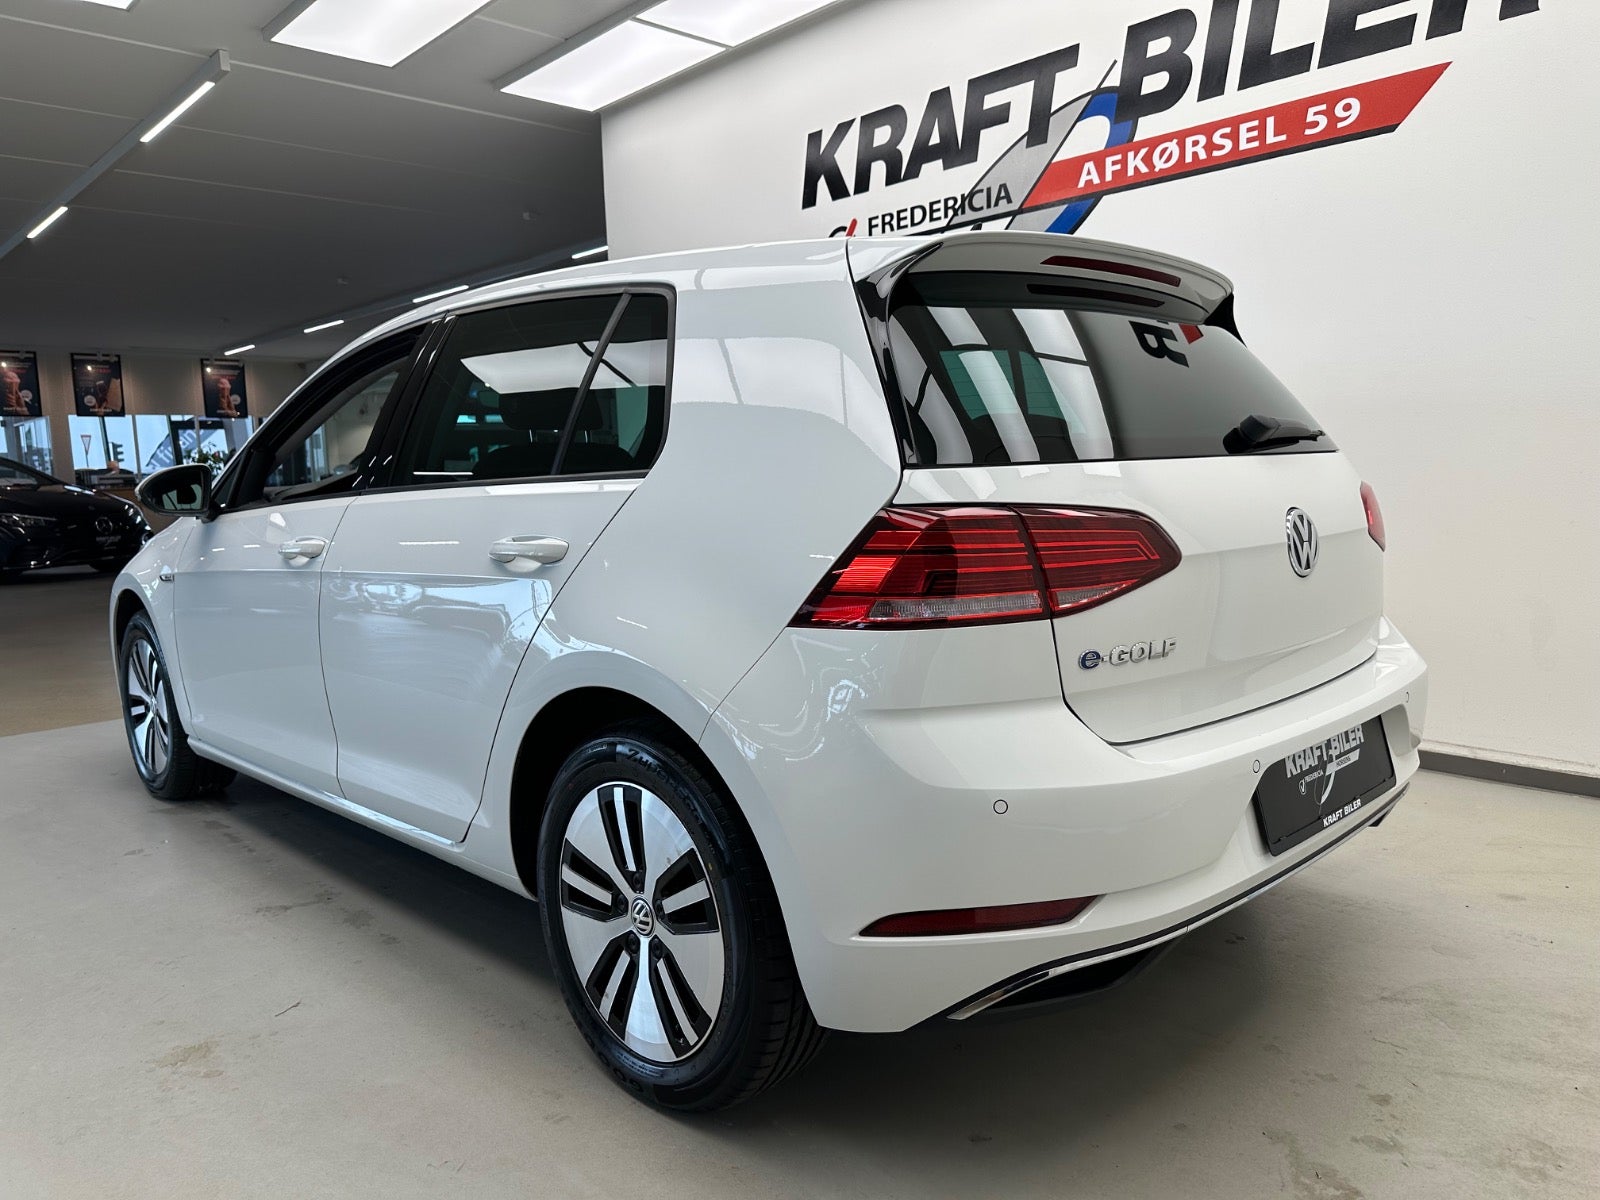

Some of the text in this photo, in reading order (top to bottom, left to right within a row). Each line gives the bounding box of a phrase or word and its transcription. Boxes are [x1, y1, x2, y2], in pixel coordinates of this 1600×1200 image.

[801, 0, 1541, 209] KRAFT BILE
[1077, 97, 1362, 189] AFKØRSEL 59
[868, 182, 1013, 237] FREDERICIA
[1078, 637, 1178, 671] e-GOLF
[1284, 724, 1364, 778] KRAFT BILER
[1322, 798, 1362, 828] KRAFT BILER
